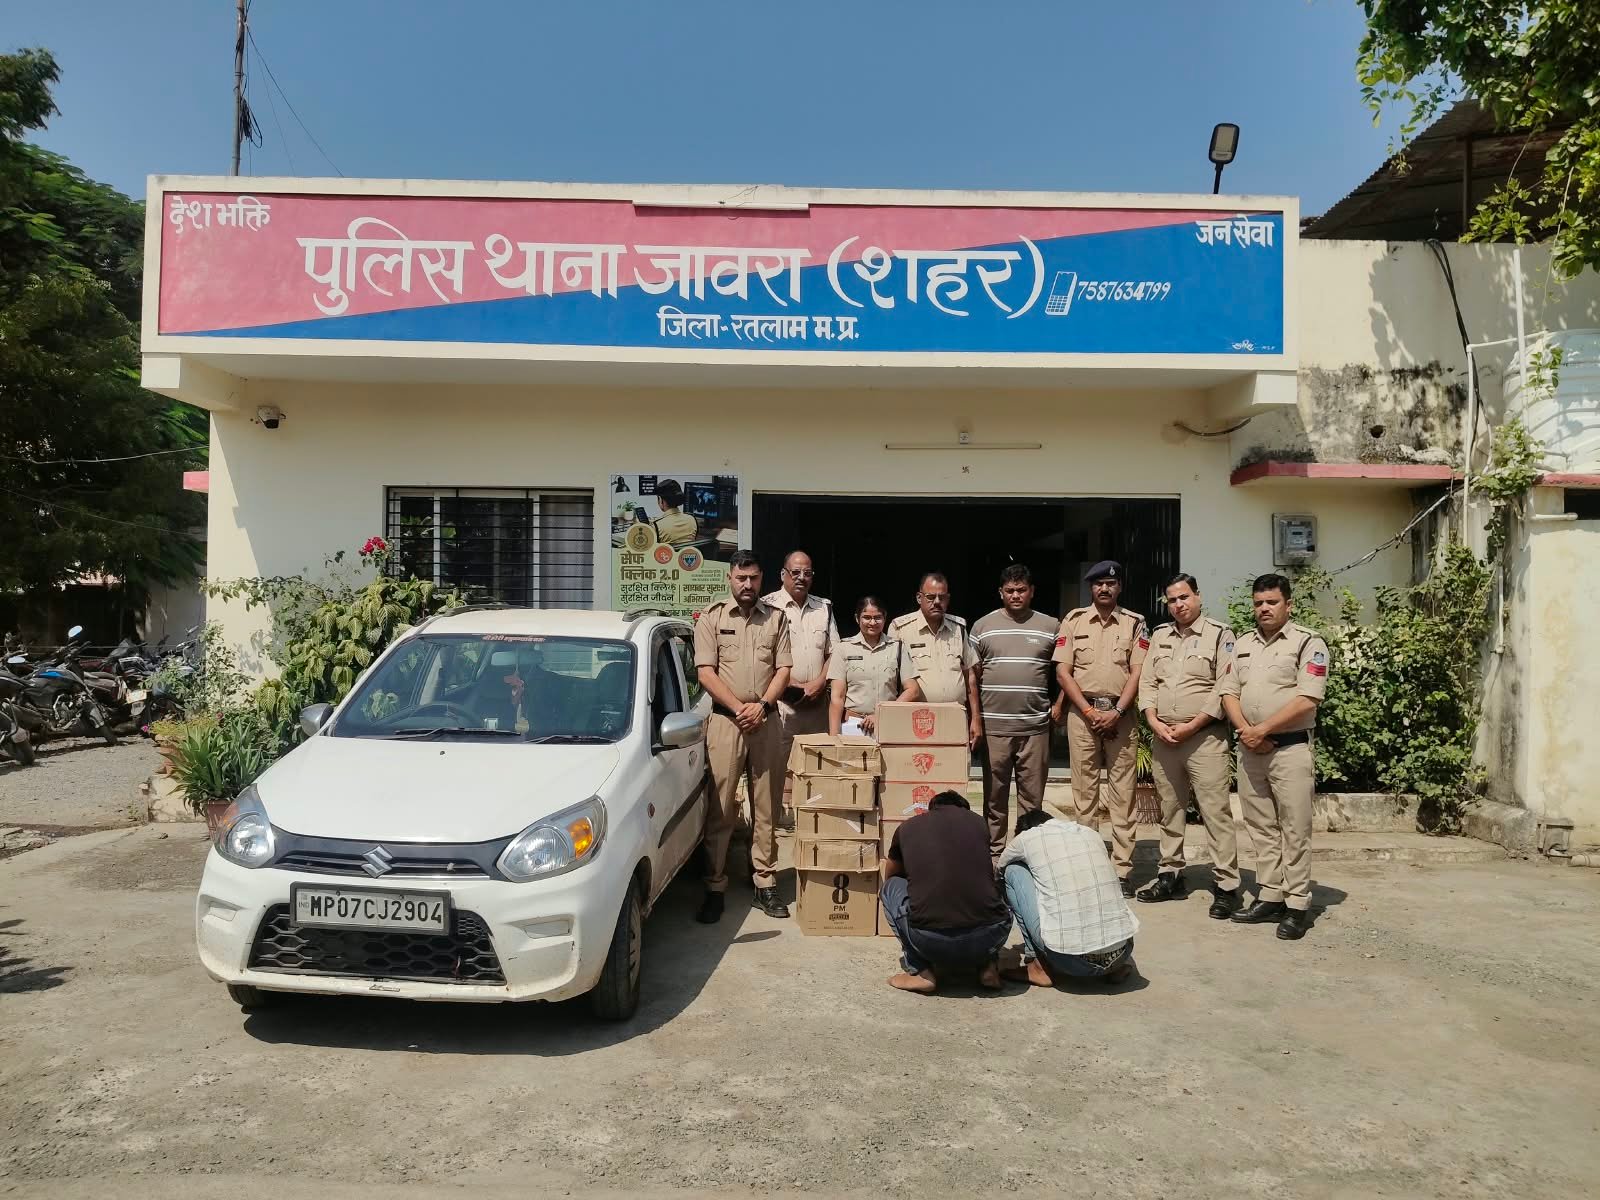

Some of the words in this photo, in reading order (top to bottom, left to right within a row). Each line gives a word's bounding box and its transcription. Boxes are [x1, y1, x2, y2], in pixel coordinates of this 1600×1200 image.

[296, 217, 475, 316] पुलिस
[485, 233, 627, 300] थाना
[633, 244, 812, 307] जावरा
[827, 235, 1045, 319] (शहर)
[1077, 281, 1171, 301] 7587634799
[620, 550, 645, 564] सेफ
[659, 569, 680, 580] 2.0
[832, 873, 850, 904] 8
[310, 895, 443, 924] MP07CJ2904
